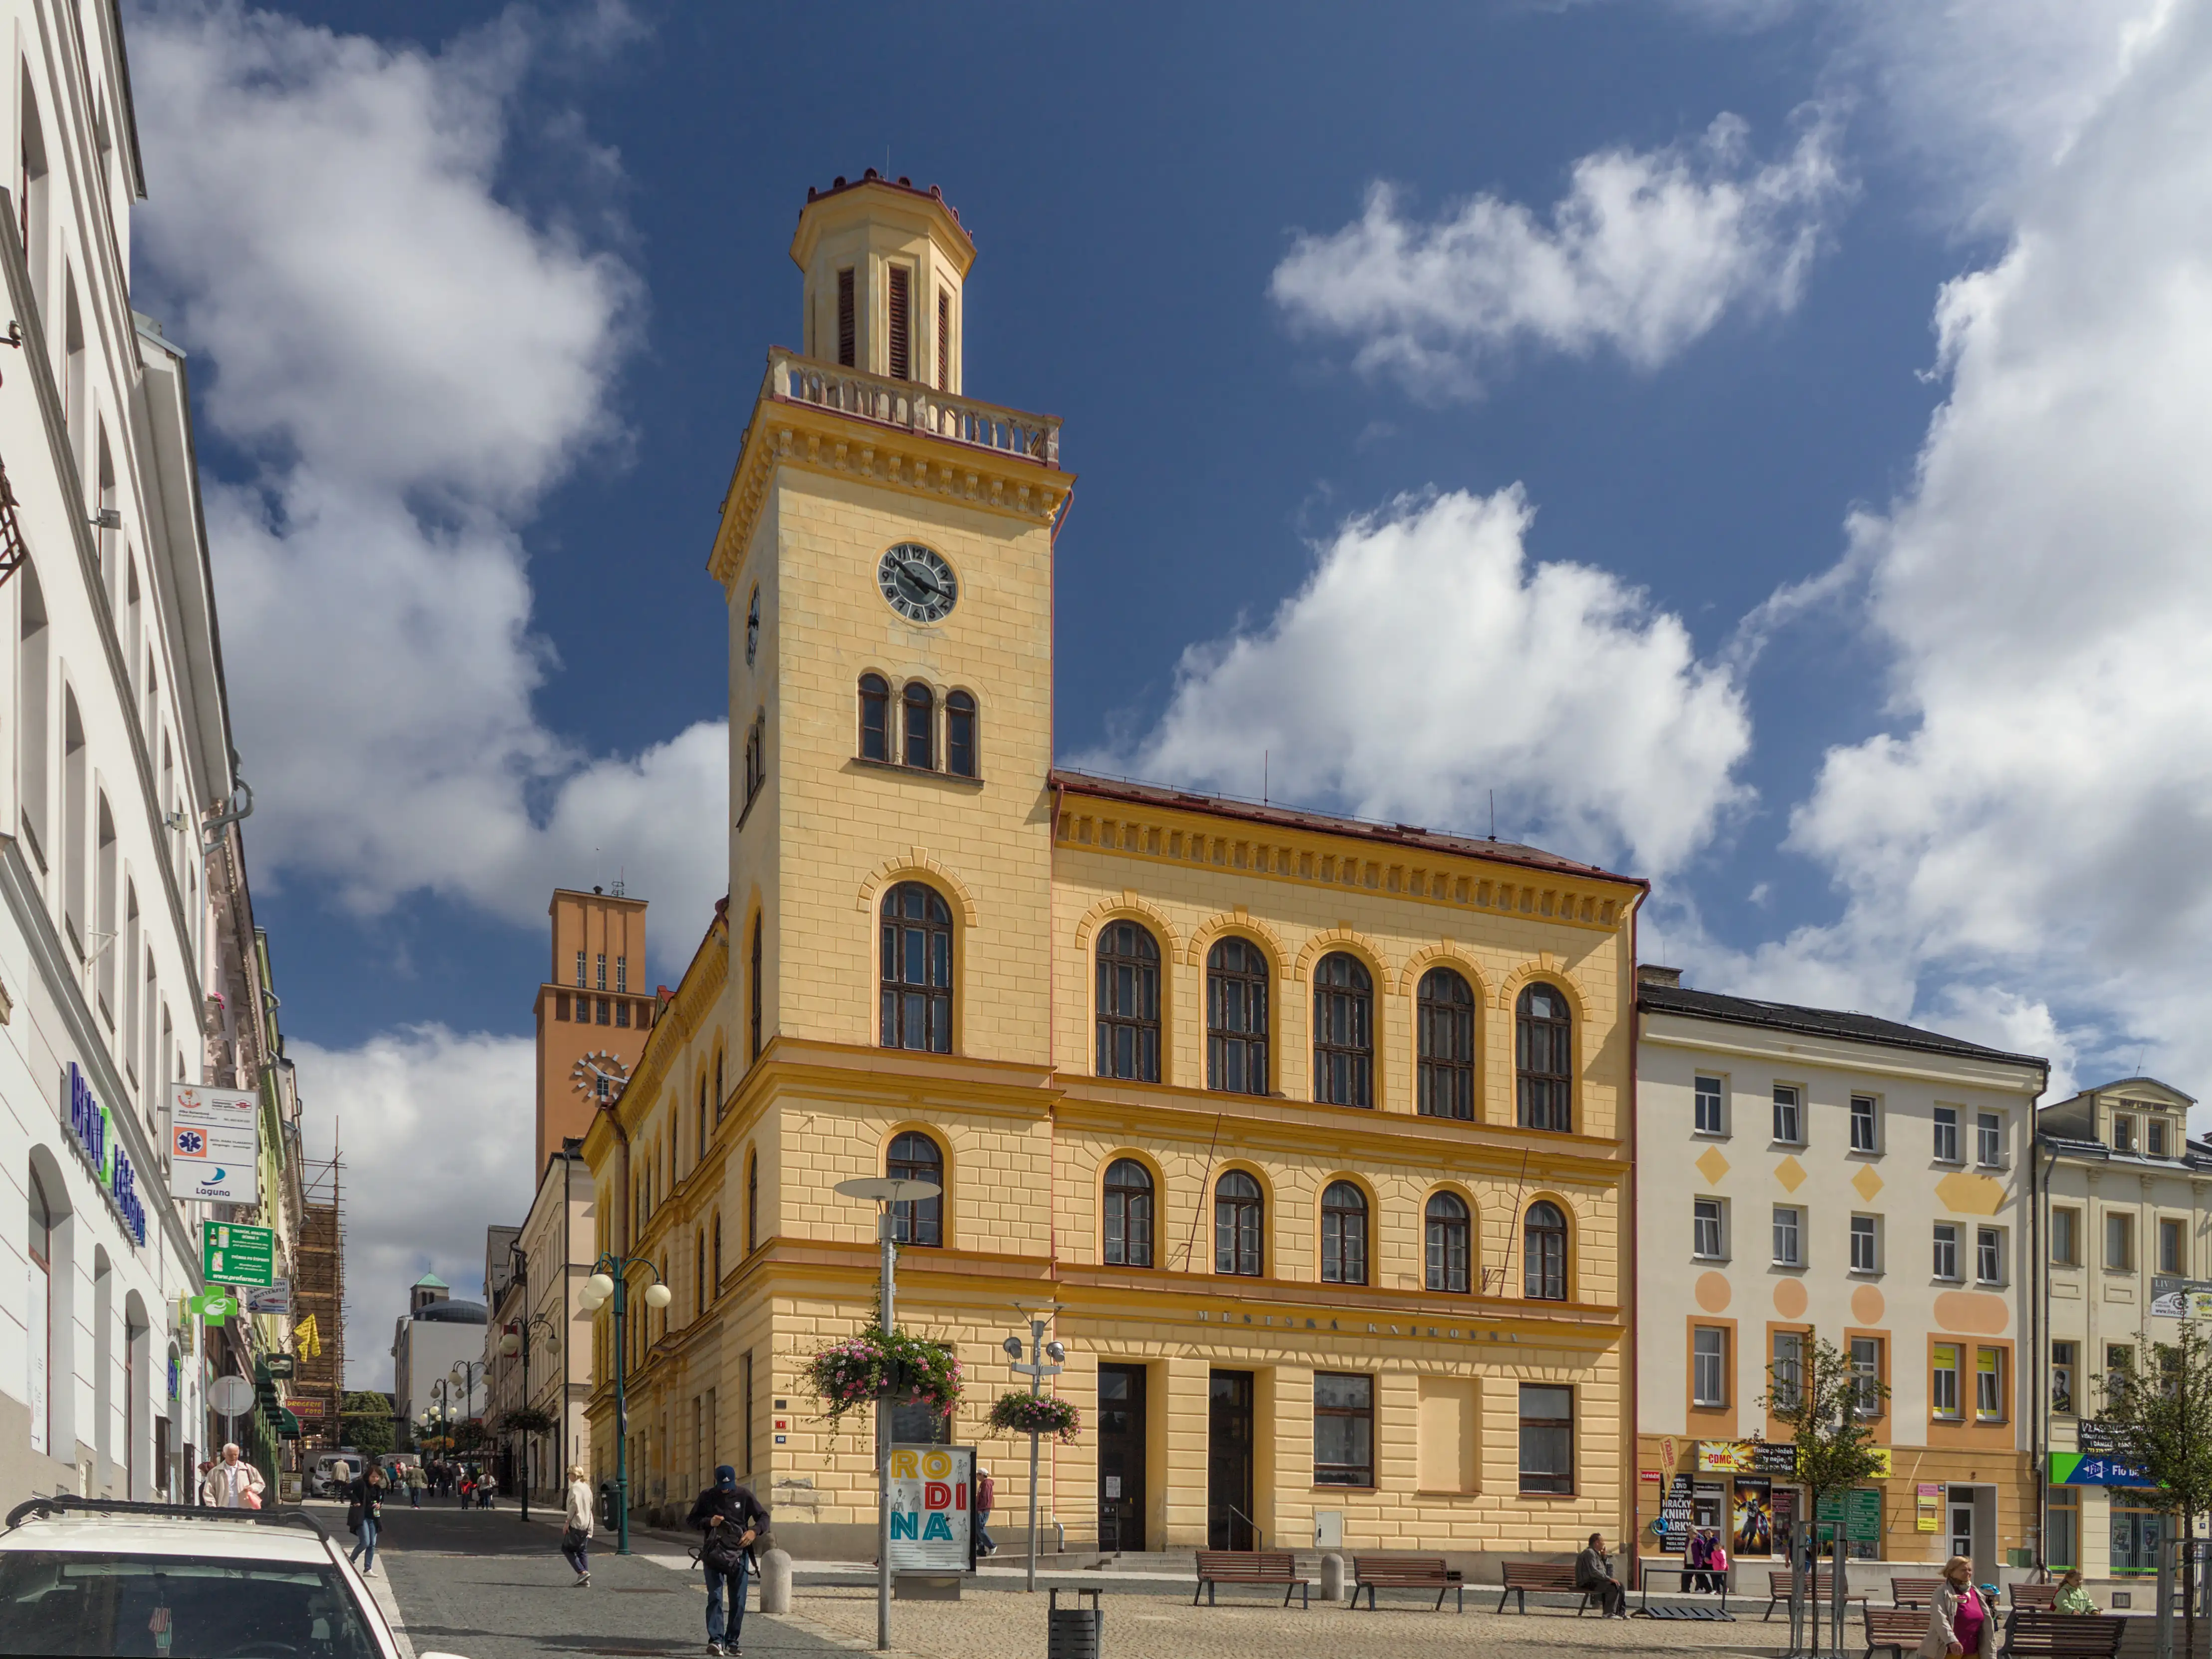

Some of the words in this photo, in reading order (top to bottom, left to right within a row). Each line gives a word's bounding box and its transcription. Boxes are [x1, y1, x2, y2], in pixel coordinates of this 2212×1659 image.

[898, 547, 905, 560] 11
[912, 547, 923, 559] 12
[885, 556, 896, 568] 10
[931, 556, 934, 567] 1
[882, 571, 889, 582] 9
[940, 570, 948, 580] 2
[886, 588, 893, 598] 8
[944, 585, 952, 595] 3
[898, 600, 906, 611] 7
[939, 600, 949, 610] 4
[912, 608, 920, 619] 6
[928, 608, 936, 619] 5
[196, 1187, 230, 1196] Laguna
[1368, 1323, 1518, 1343] KNIHOVNA
[891, 1450, 952, 1480] RO
[2090, 1464, 2100, 1474] Fio
[2112, 1465, 2127, 1476] Fio
[925, 1481, 967, 1510] DI
[1662, 1508, 1692, 1519] KNIHY
[890, 1512, 953, 1541] NA
